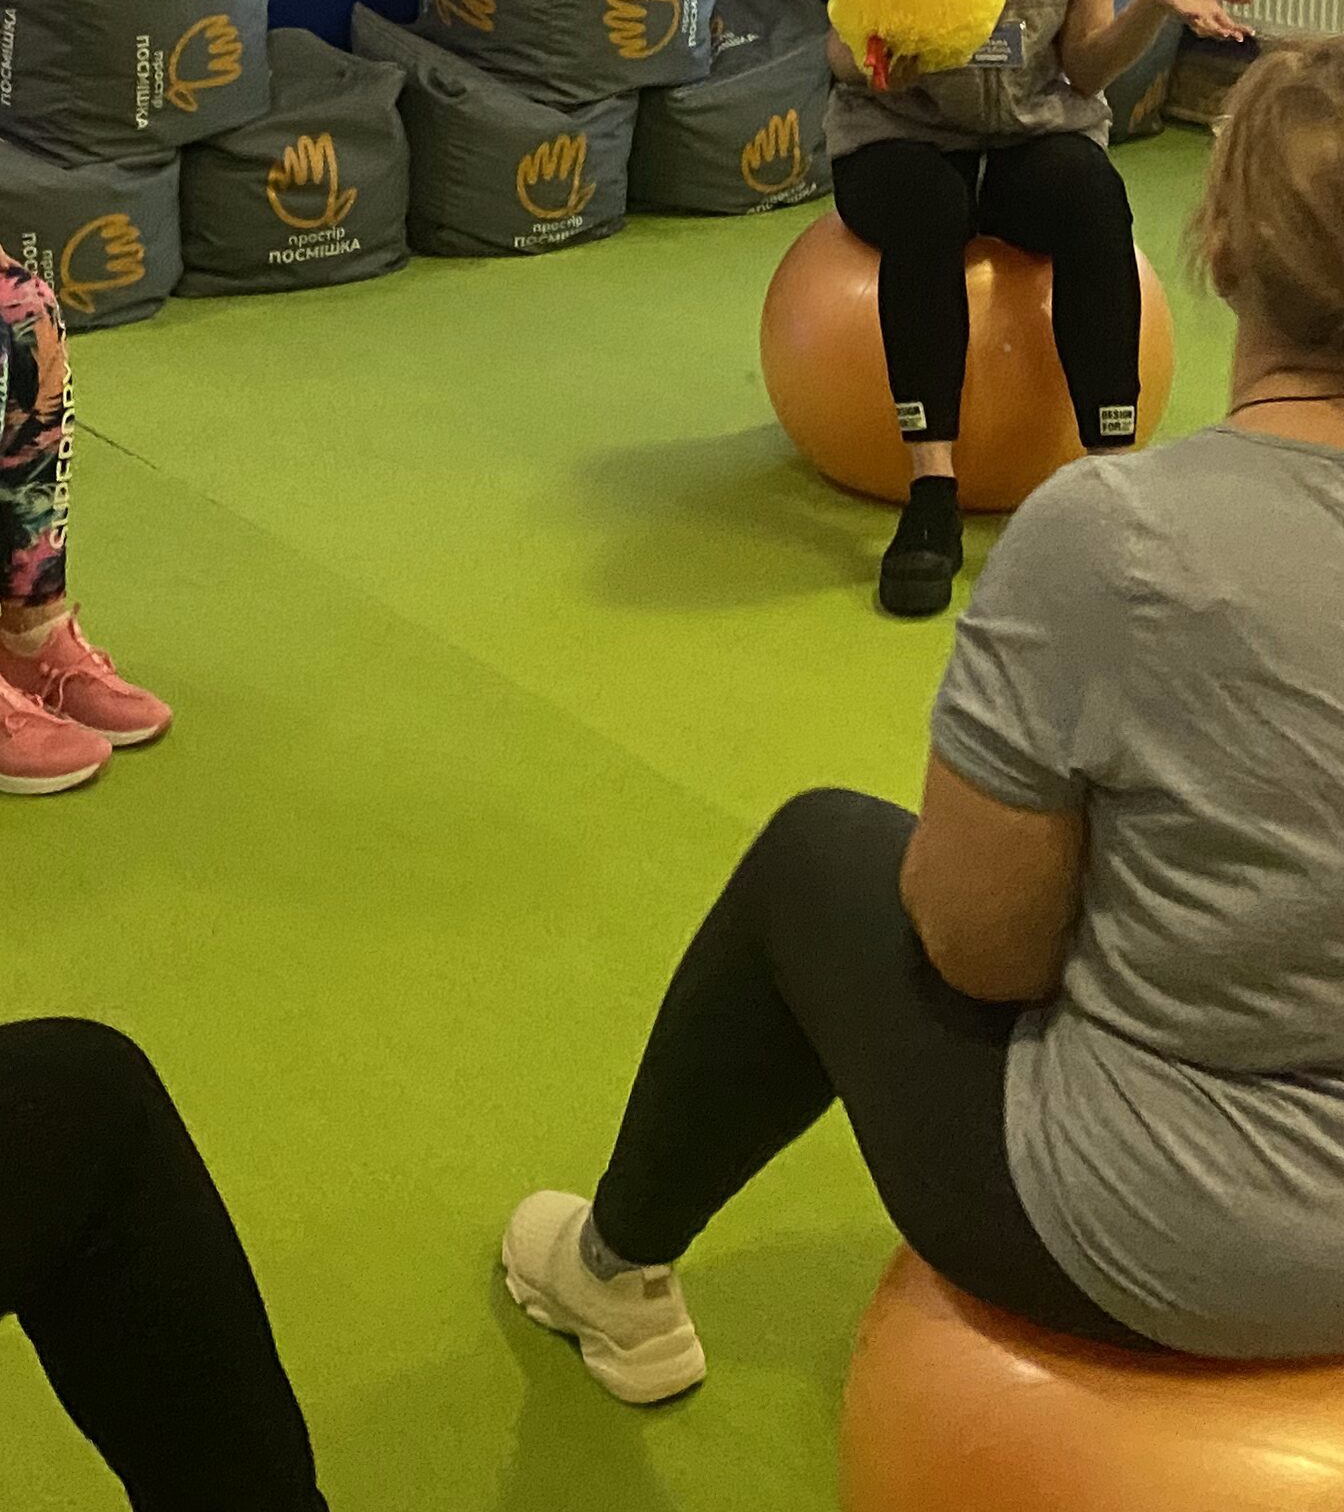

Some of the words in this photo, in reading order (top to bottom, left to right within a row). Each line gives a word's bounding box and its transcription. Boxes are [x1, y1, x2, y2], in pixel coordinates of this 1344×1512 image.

[0, 7, 16, 106] ПОСМІШКА
[136, 35, 150, 130] ПОСМІШКА
[269, 238, 361, 264] ПОСМІШКА
[288, 226, 346, 248] простір
